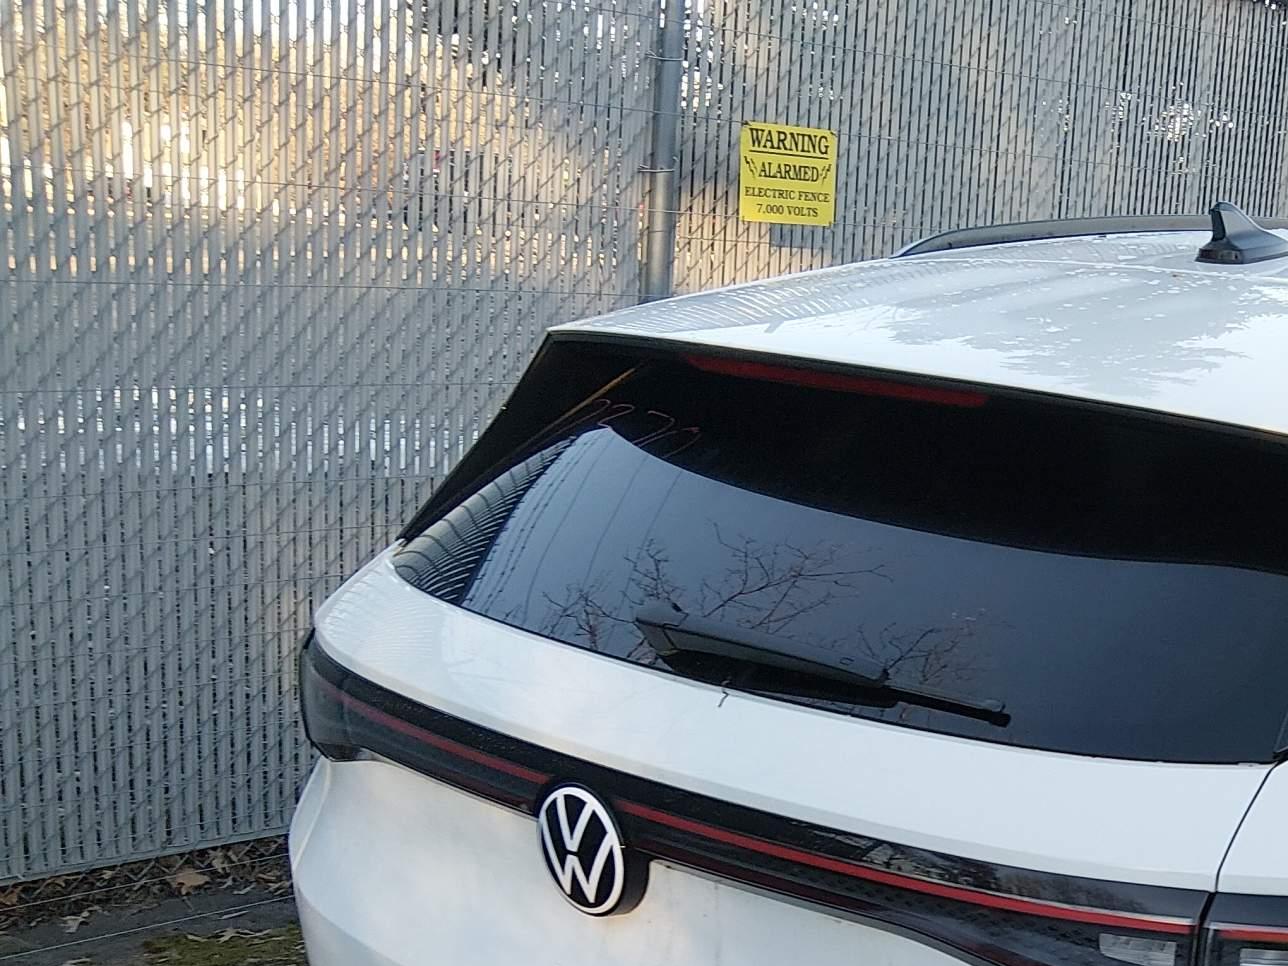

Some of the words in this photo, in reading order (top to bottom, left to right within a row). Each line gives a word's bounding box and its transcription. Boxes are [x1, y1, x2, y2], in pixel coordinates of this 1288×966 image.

[748, 127, 830, 155] WARNING
[758, 161, 820, 182] ALARMED
[744, 186, 797, 200] ELECTRIC
[798, 191, 830, 203] FENCE
[787, 205, 819, 217] VOLTS
